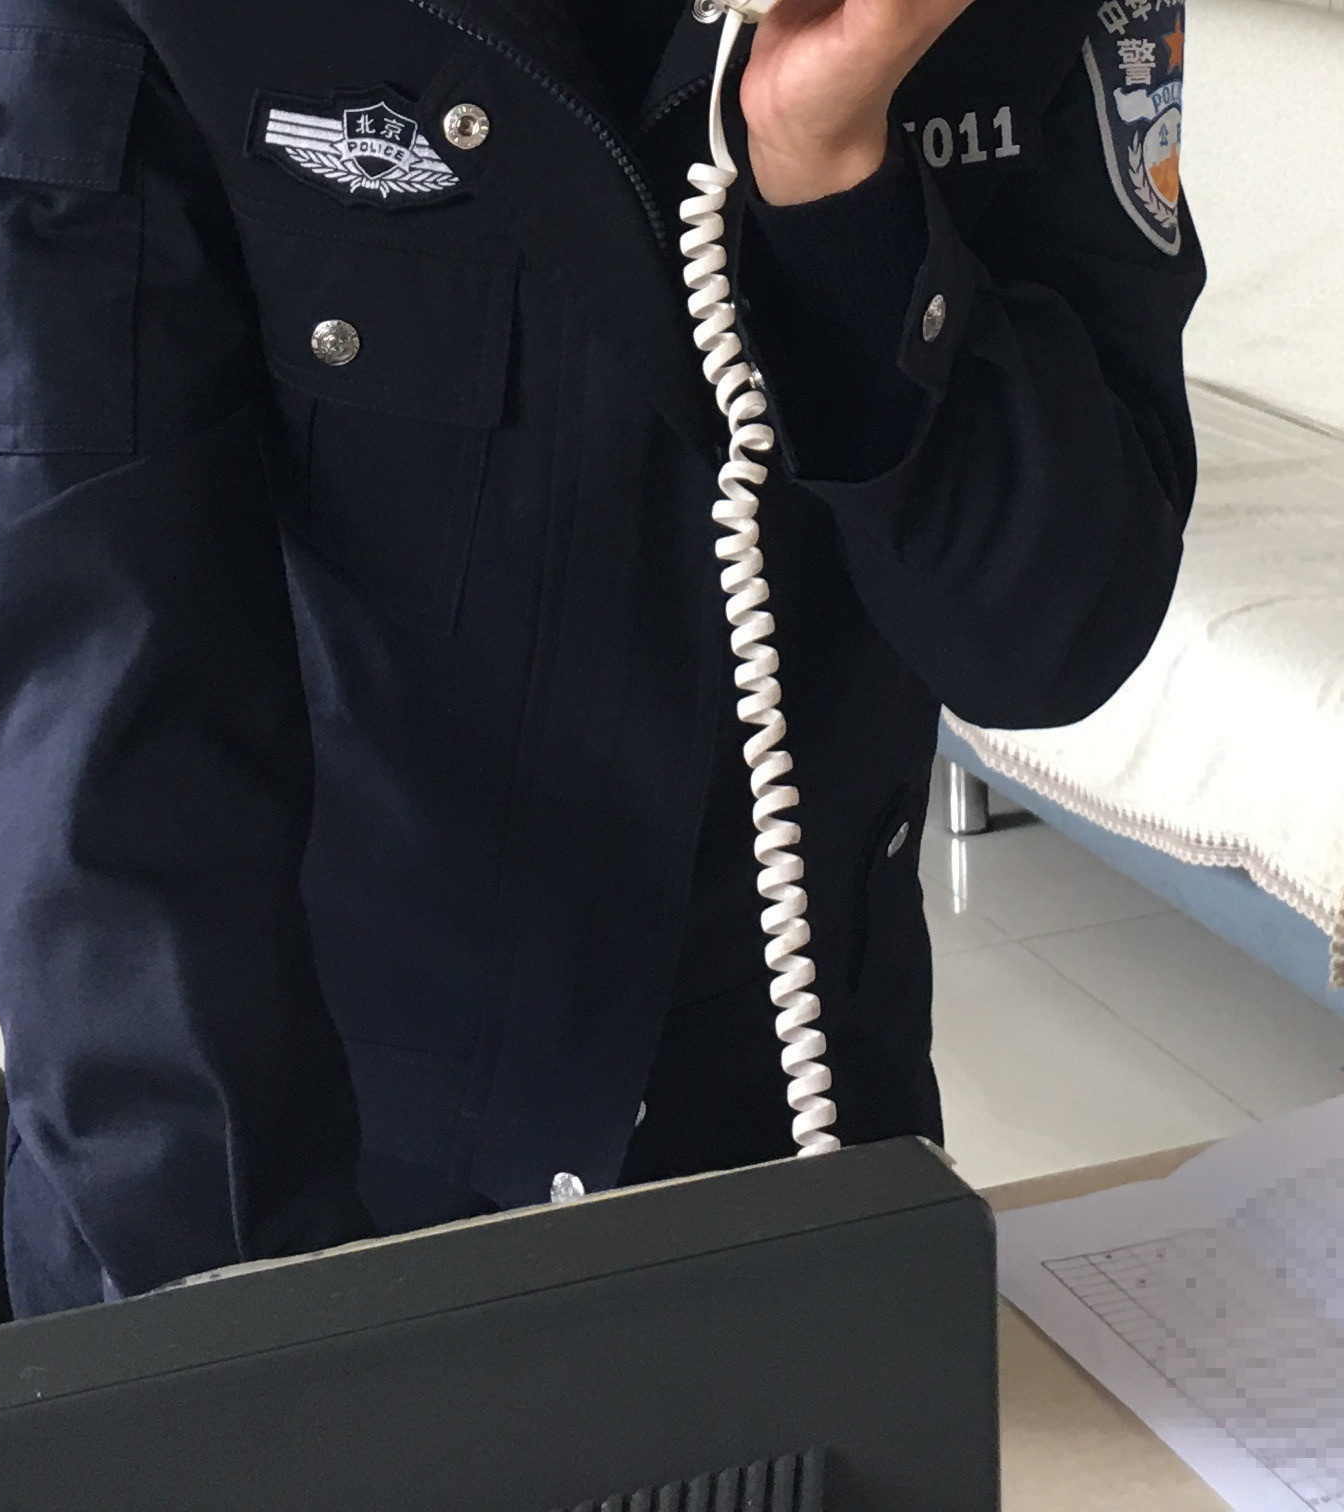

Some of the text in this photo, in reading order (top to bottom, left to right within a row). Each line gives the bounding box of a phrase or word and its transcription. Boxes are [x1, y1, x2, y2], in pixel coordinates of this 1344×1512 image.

[1116, 38, 1157, 86] 警
[356, 114, 405, 139] 北京
[902, 105, 1021, 169] 011
[347, 141, 405, 162] POLICE
